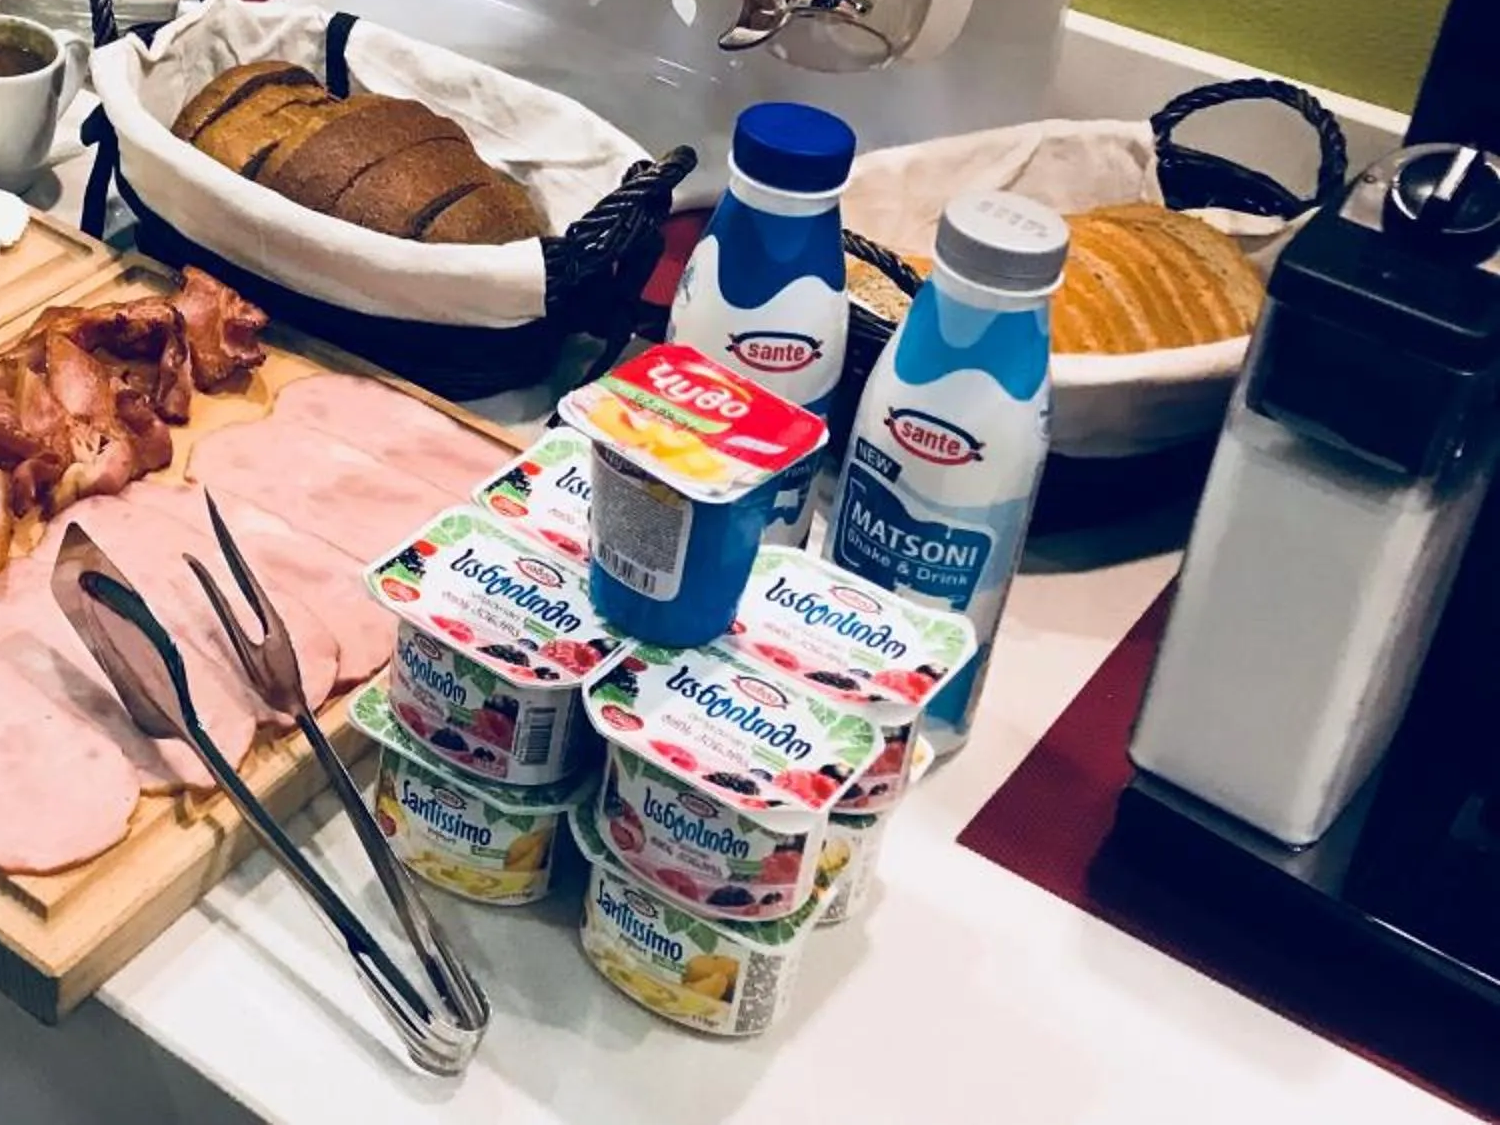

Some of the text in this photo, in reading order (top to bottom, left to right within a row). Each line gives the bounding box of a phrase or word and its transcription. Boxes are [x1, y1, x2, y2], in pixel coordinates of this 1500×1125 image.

[747, 340, 806, 363] sante
[900, 420, 962, 456] sante
[858, 442, 893, 475] NEW
[850, 500, 979, 568] MATSONI
[846, 528, 968, 586] Shake & Drink
